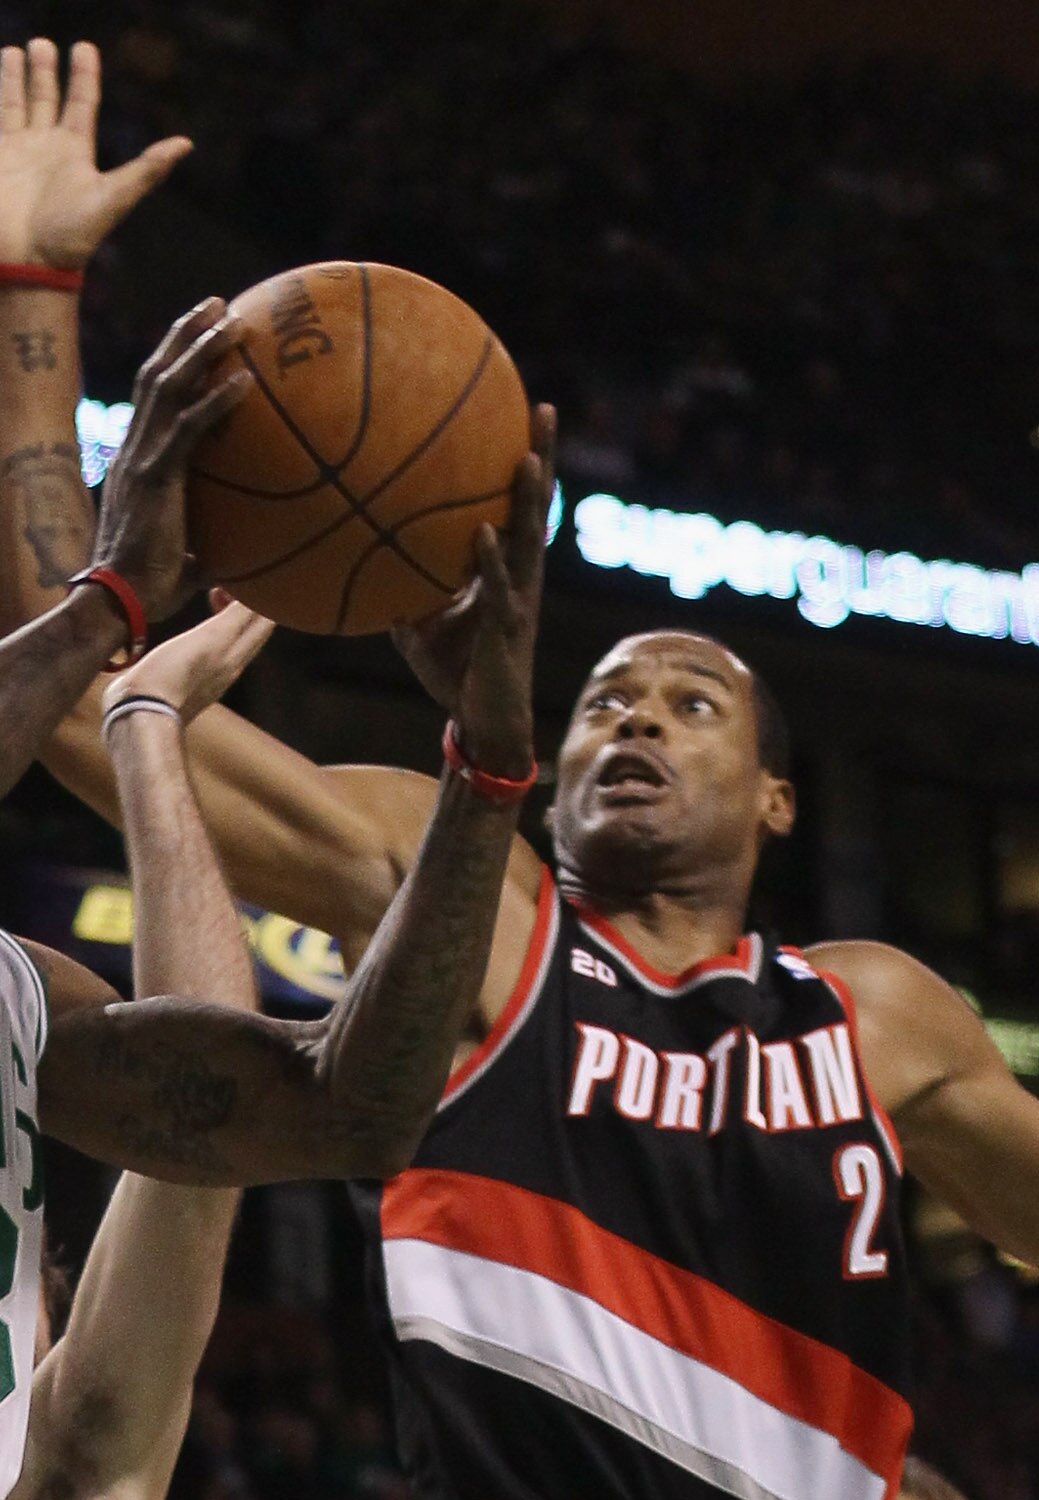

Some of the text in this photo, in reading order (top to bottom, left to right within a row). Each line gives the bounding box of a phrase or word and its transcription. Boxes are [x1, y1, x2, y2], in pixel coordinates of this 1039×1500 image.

[571, 948, 618, 987] 20
[565, 1017, 864, 1137] PORTLAN
[832, 1141, 889, 1281] 2
